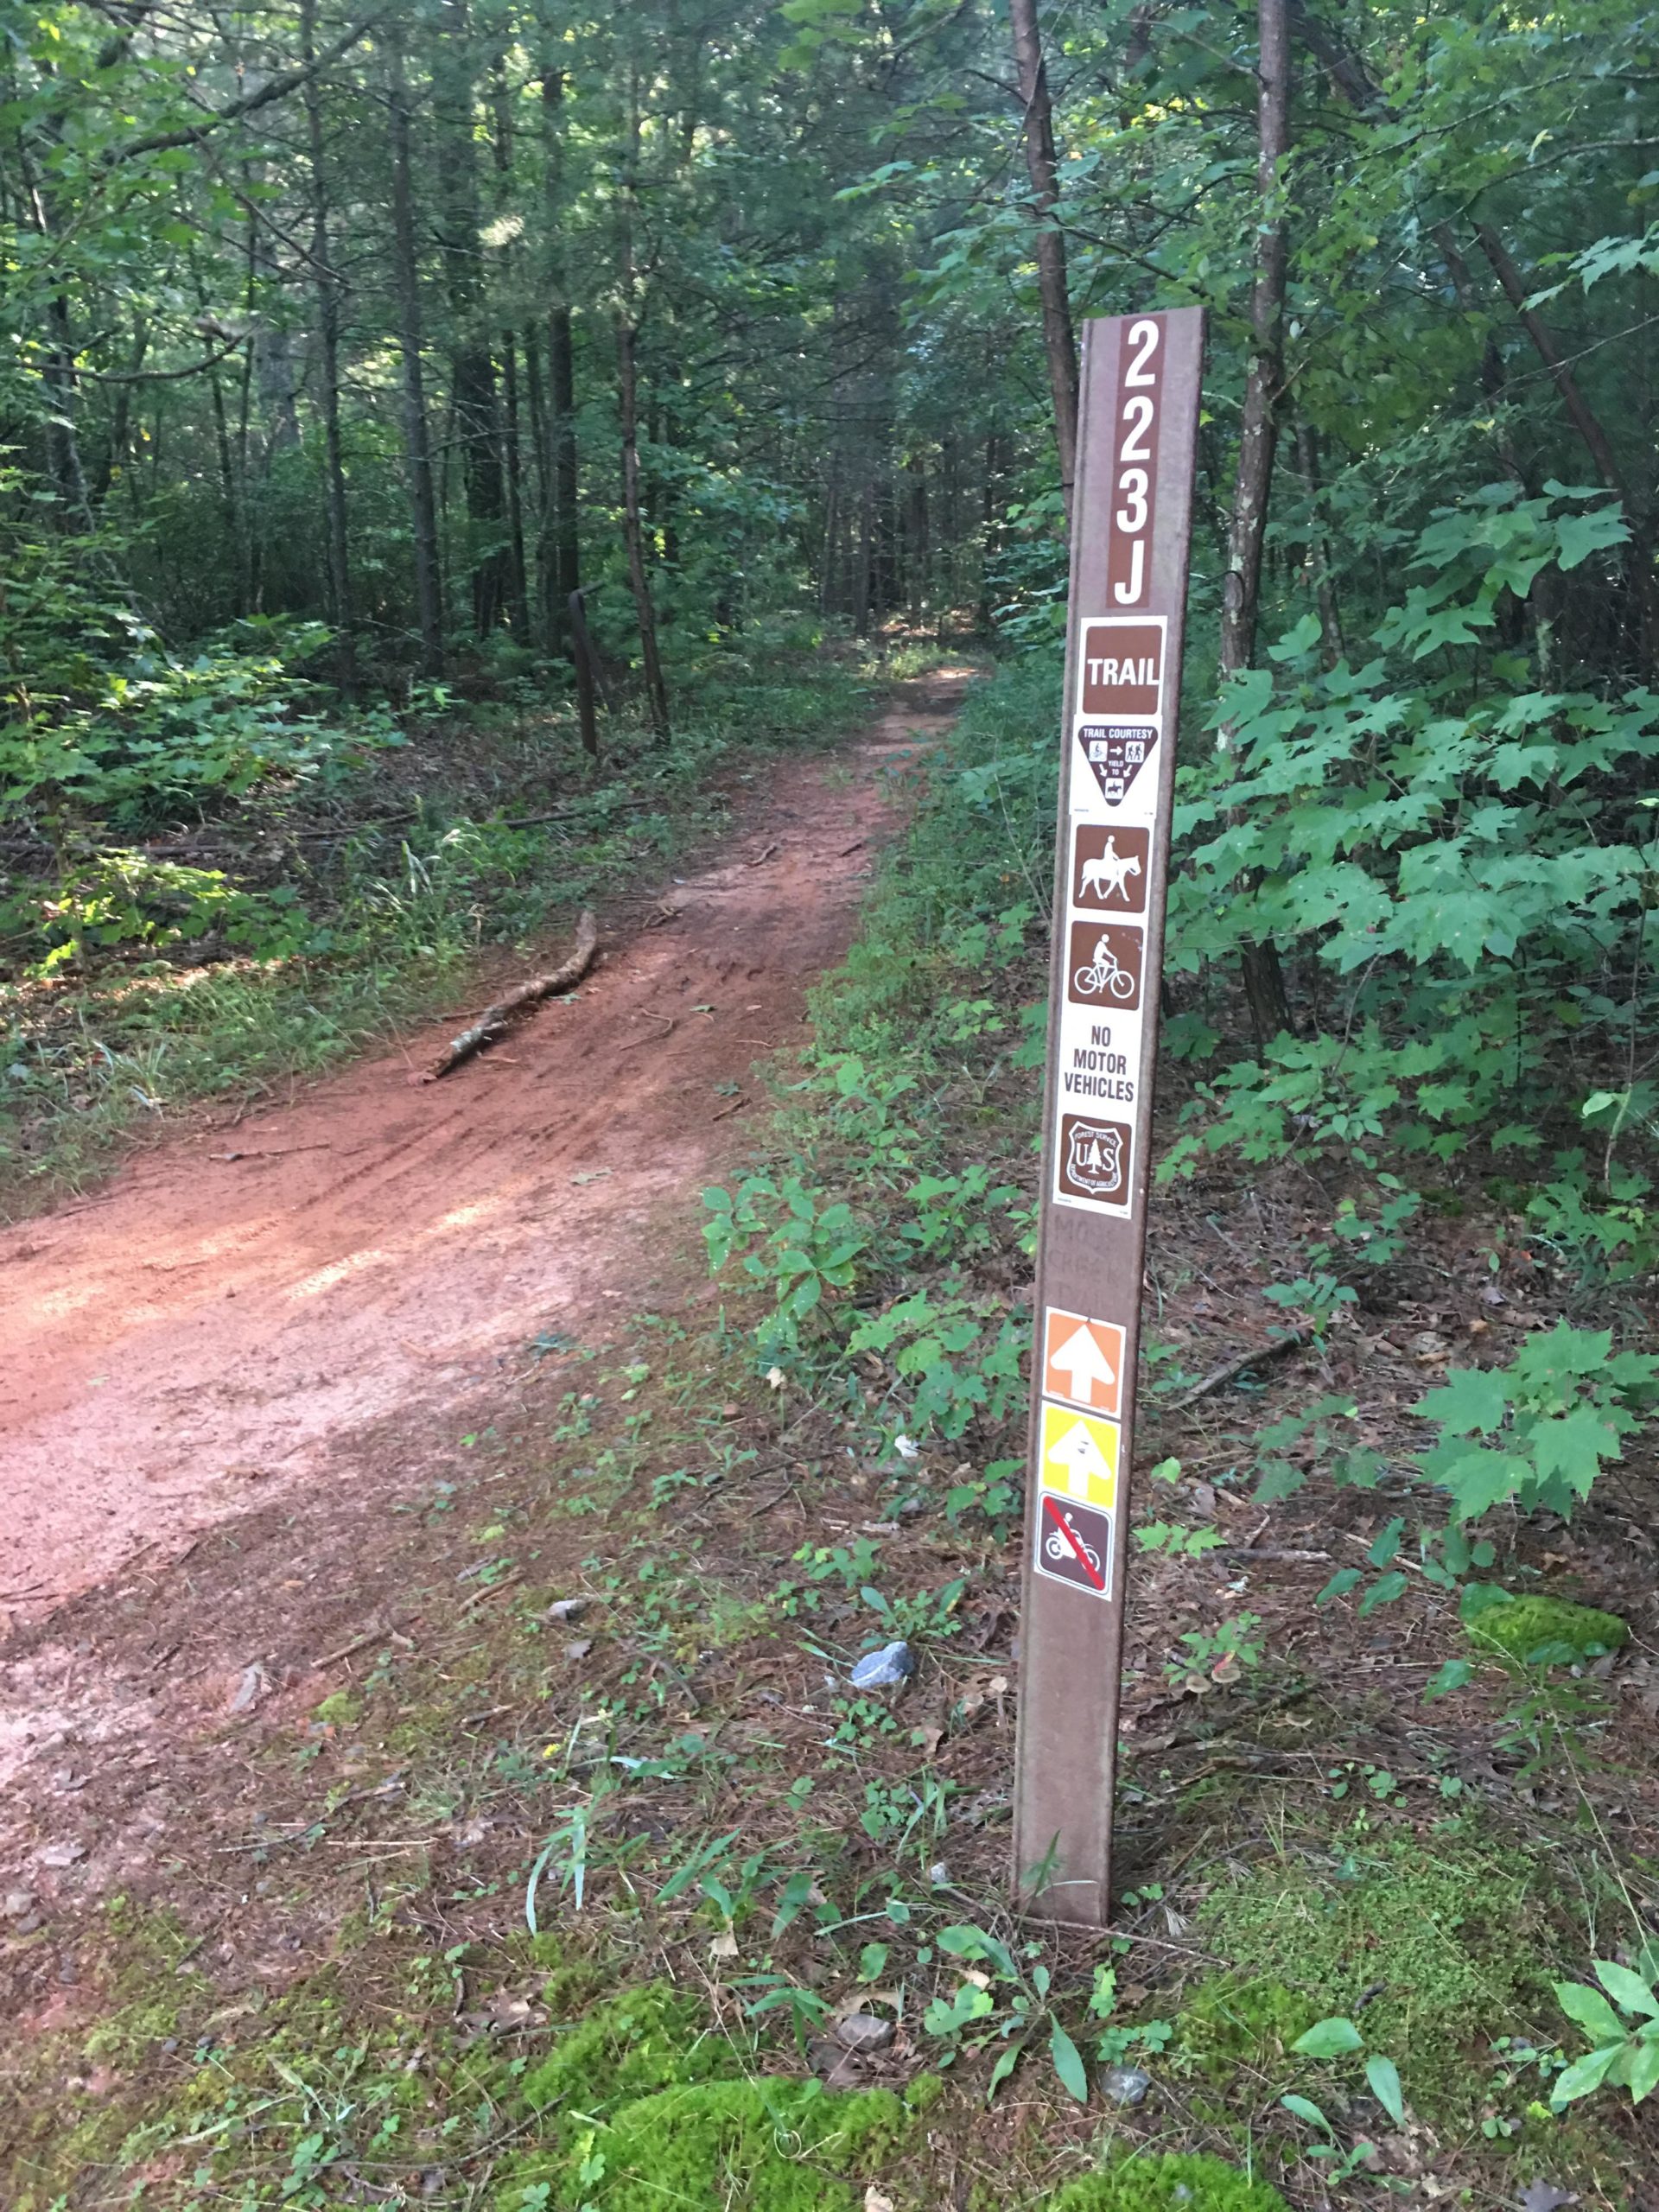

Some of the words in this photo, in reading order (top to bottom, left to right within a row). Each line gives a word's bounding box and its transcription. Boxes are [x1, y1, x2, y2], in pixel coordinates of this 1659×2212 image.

[1114, 319, 1160, 605] 223J
[1087, 658, 1160, 685] TRAIL
[1084, 728, 1106, 738] TRAIL
[1109, 728, 1154, 739] COURTESY
[1090, 1025, 1111, 1047] NO
[1073, 1048, 1127, 1075] MOTOR
[1064, 1071, 1135, 1103] VEHICLES
[1075, 1130, 1094, 1141] FOREST
[1096, 1132, 1117, 1147] SERVICE
